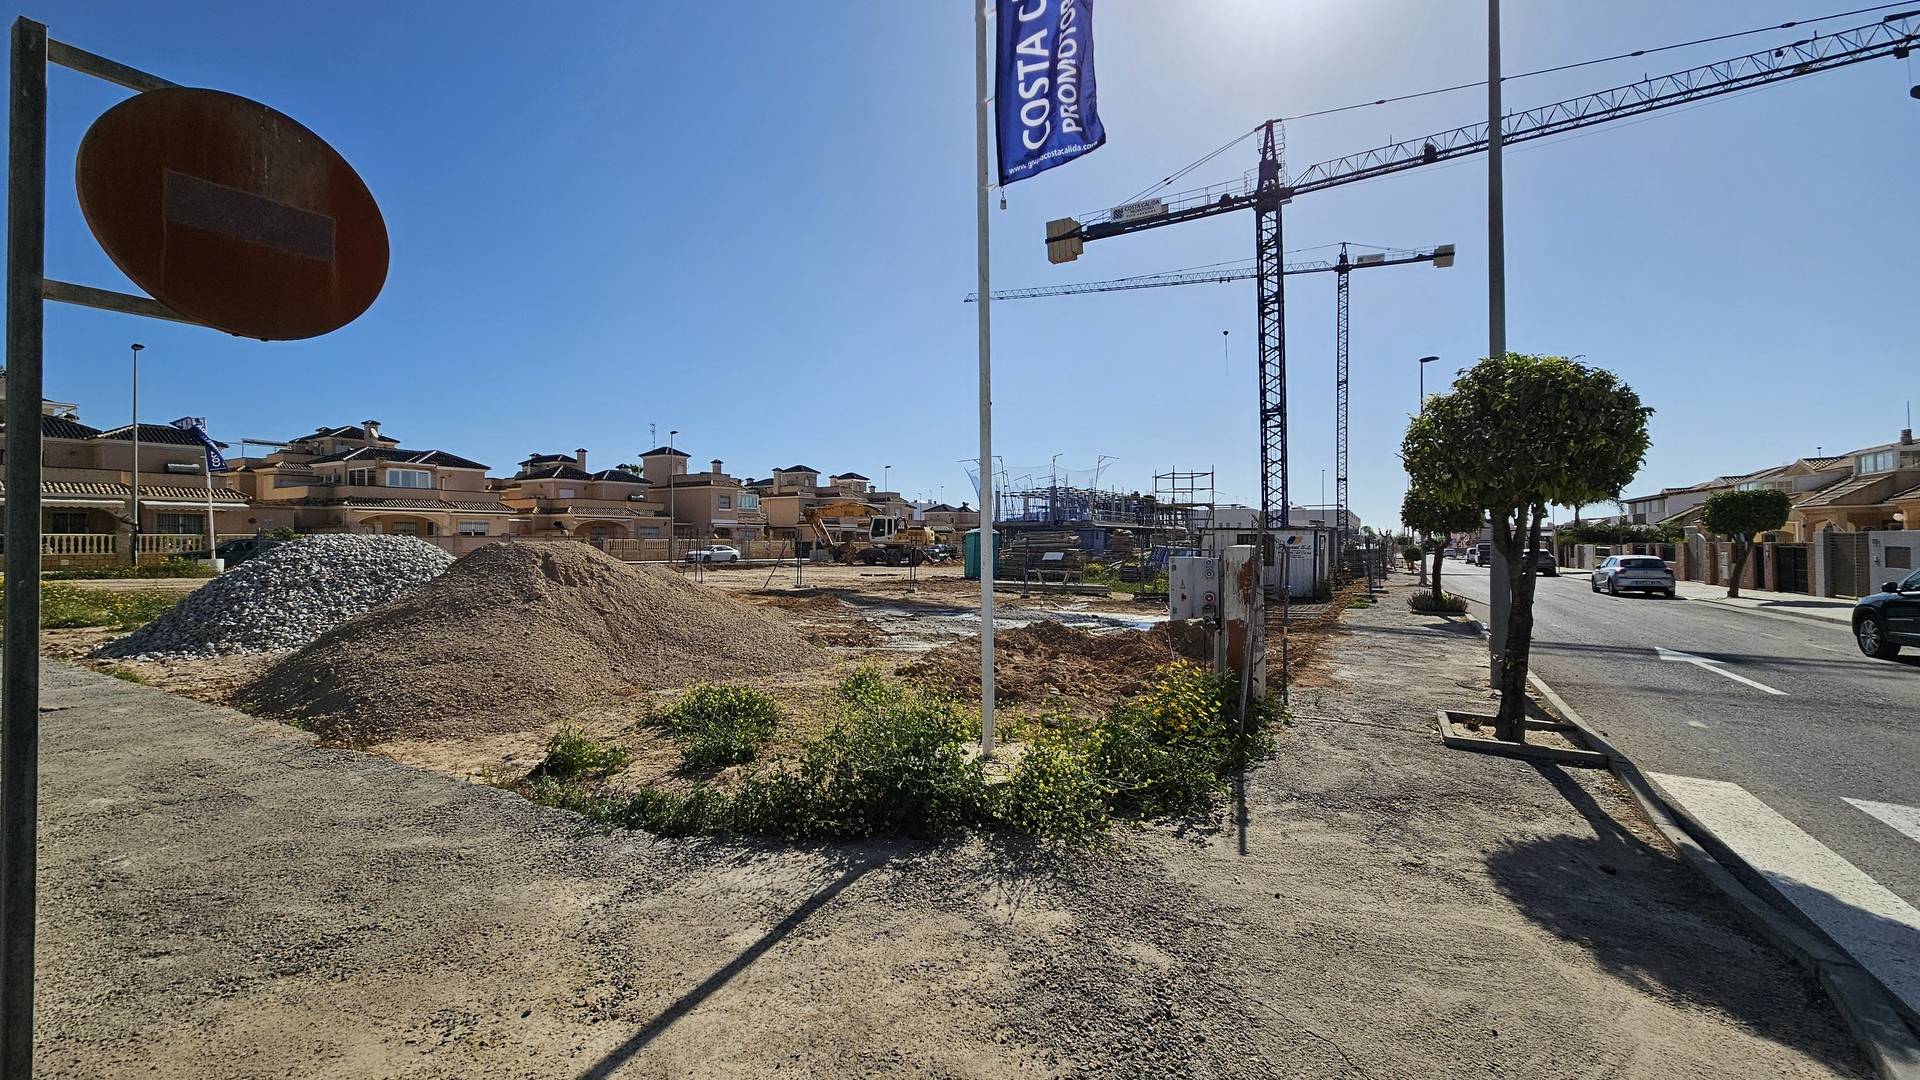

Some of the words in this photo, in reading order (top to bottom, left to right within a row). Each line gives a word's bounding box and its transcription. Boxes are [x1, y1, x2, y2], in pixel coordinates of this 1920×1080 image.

[1018, 0, 1047, 21] C
[1016, 28, 1050, 150] COSTA
[1009, 142, 1098, 174] www.grupocostacalida.com
